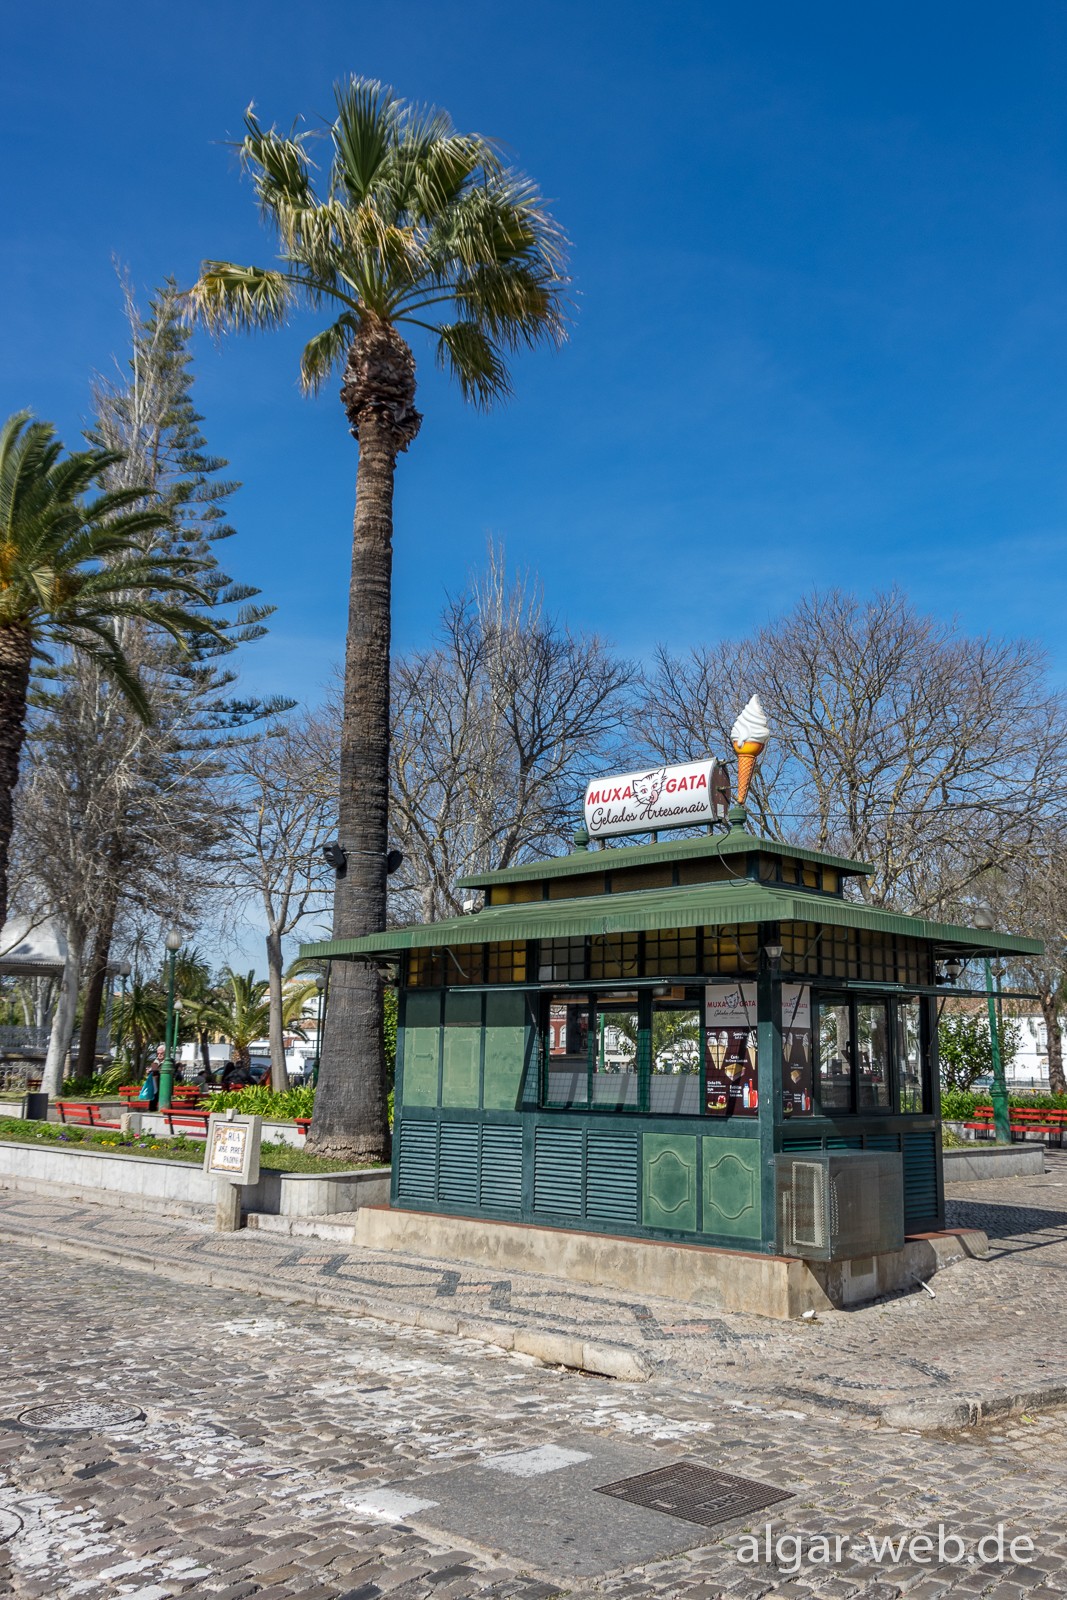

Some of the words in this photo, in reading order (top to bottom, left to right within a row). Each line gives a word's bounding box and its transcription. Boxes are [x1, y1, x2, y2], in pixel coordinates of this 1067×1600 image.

[587, 785, 632, 806] MUXA
[665, 773, 707, 794] GATA
[590, 807, 638, 832] Gelados
[639, 801, 709, 821] Artesanais
